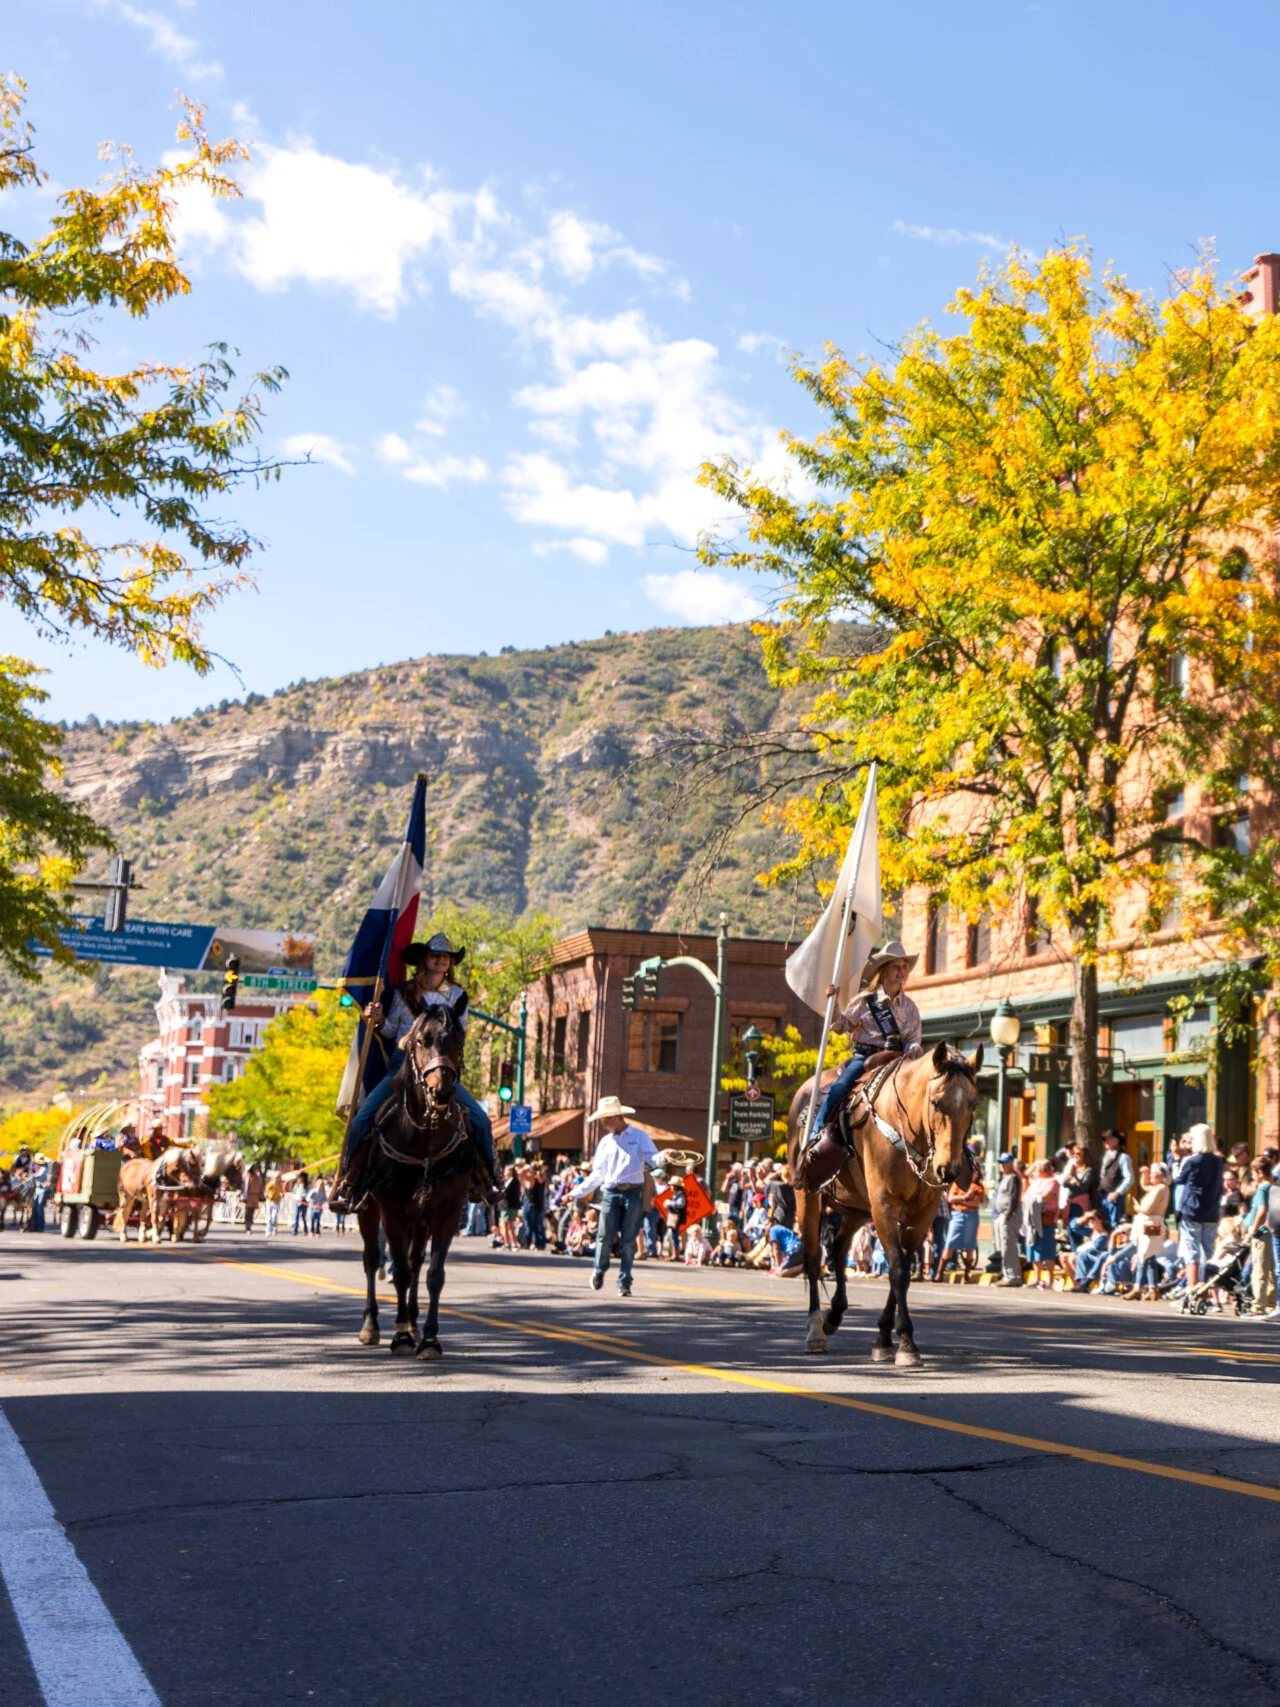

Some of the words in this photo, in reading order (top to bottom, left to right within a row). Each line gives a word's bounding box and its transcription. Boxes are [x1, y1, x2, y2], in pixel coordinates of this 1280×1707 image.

[170, 927, 193, 938] CARE
[276, 977, 311, 991] STREET
[1033, 1056, 1109, 1078] livy
